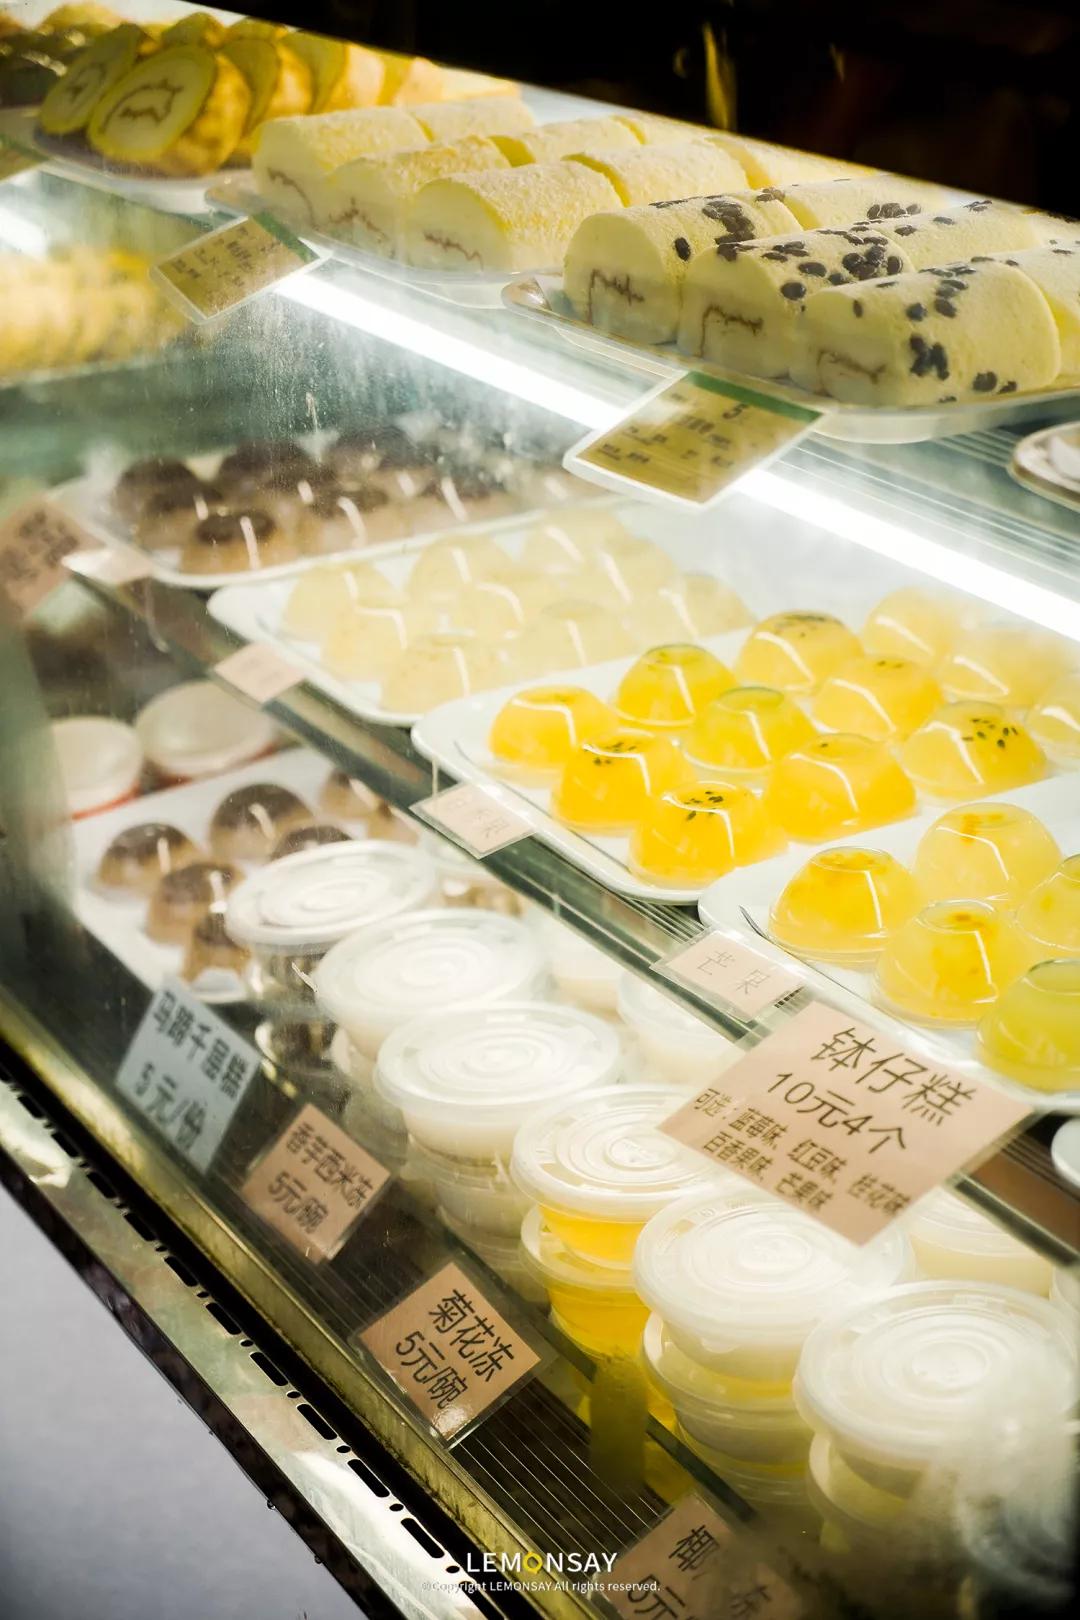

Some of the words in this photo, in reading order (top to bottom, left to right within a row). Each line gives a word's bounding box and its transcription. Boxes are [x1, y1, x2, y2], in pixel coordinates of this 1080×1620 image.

[766, 1072, 907, 1154] 10元4个
[810, 1027, 977, 1126] 钵仔糕
[428, 1289, 515, 1382] 菊花冻
